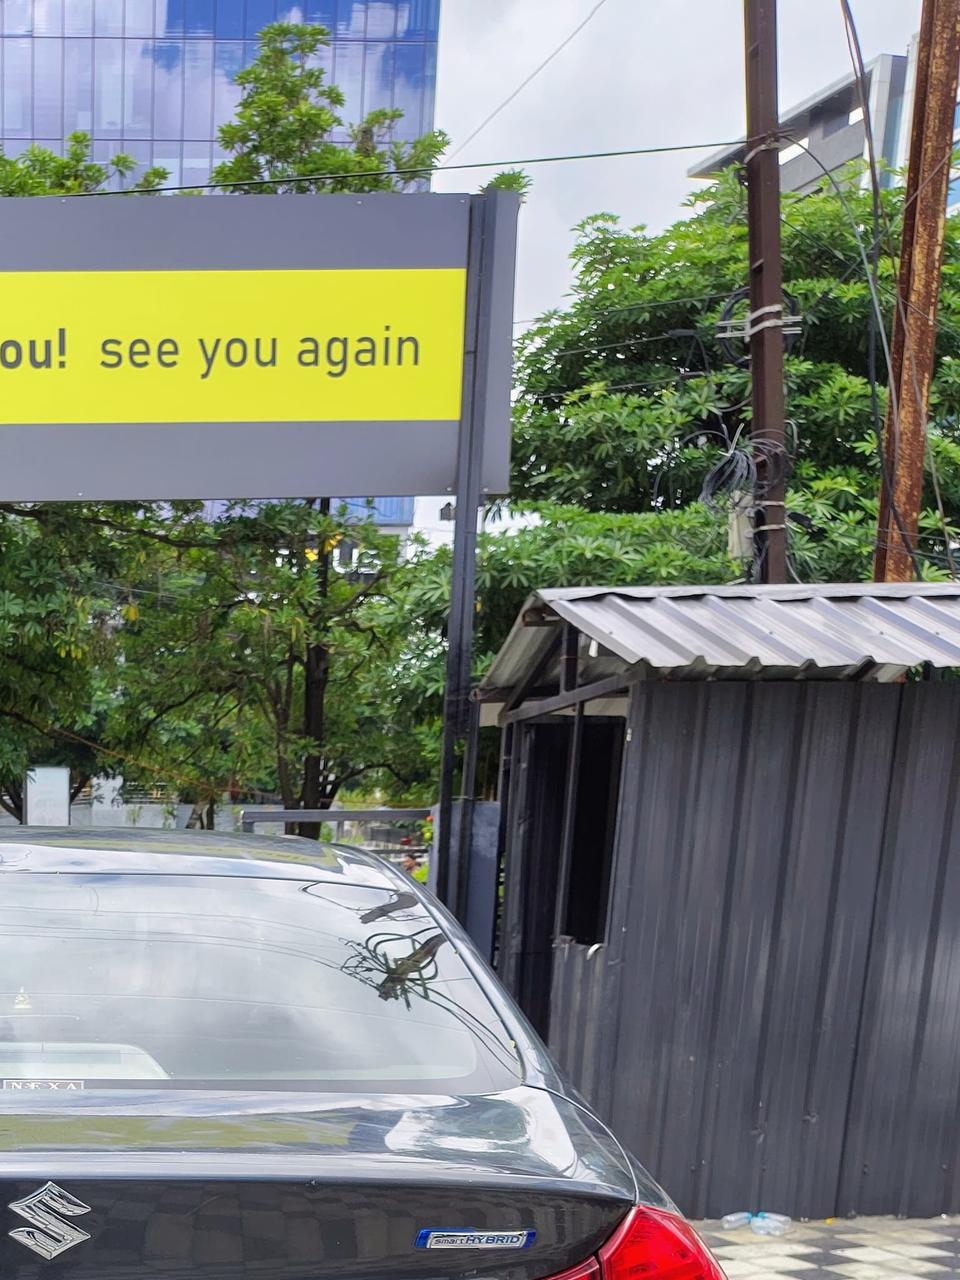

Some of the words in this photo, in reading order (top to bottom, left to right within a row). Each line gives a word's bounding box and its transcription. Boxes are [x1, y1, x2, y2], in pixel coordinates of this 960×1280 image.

[99, 334, 181, 369] see
[198, 333, 277, 379] you
[297, 325, 420, 378] again
